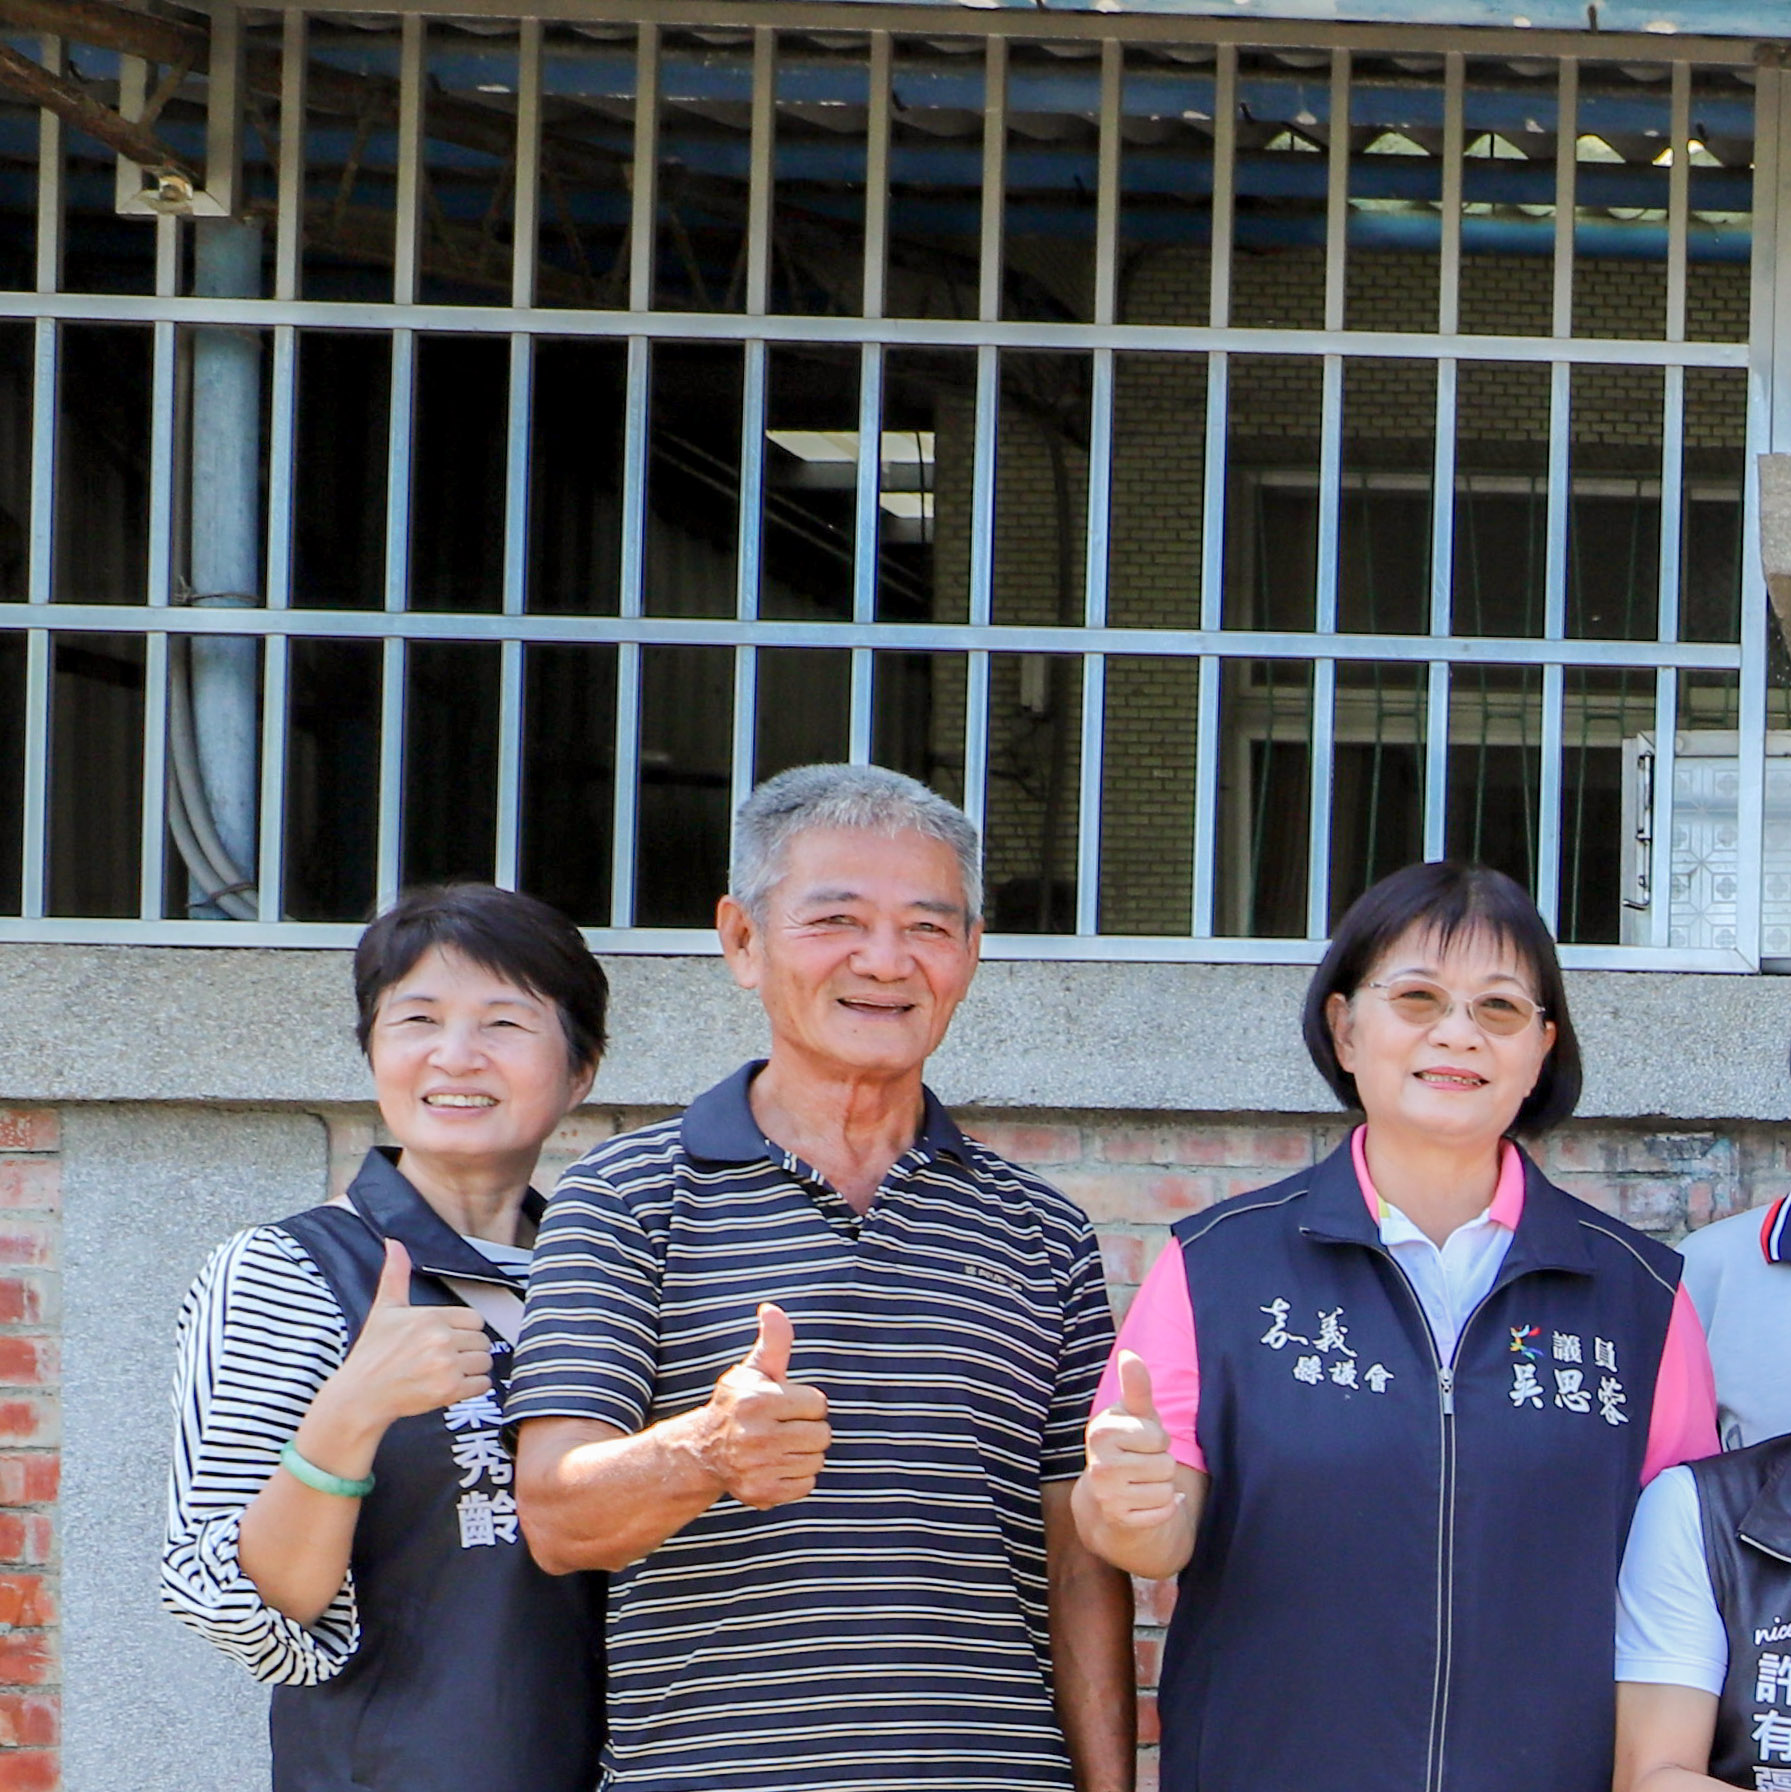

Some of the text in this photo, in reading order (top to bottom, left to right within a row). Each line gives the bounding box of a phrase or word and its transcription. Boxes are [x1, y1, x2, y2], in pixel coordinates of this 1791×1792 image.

[1260, 1298, 1357, 1357] 嘉義
[1552, 1330, 1618, 1373] 議員
[1509, 1363, 1629, 1425] 吳思蓉
